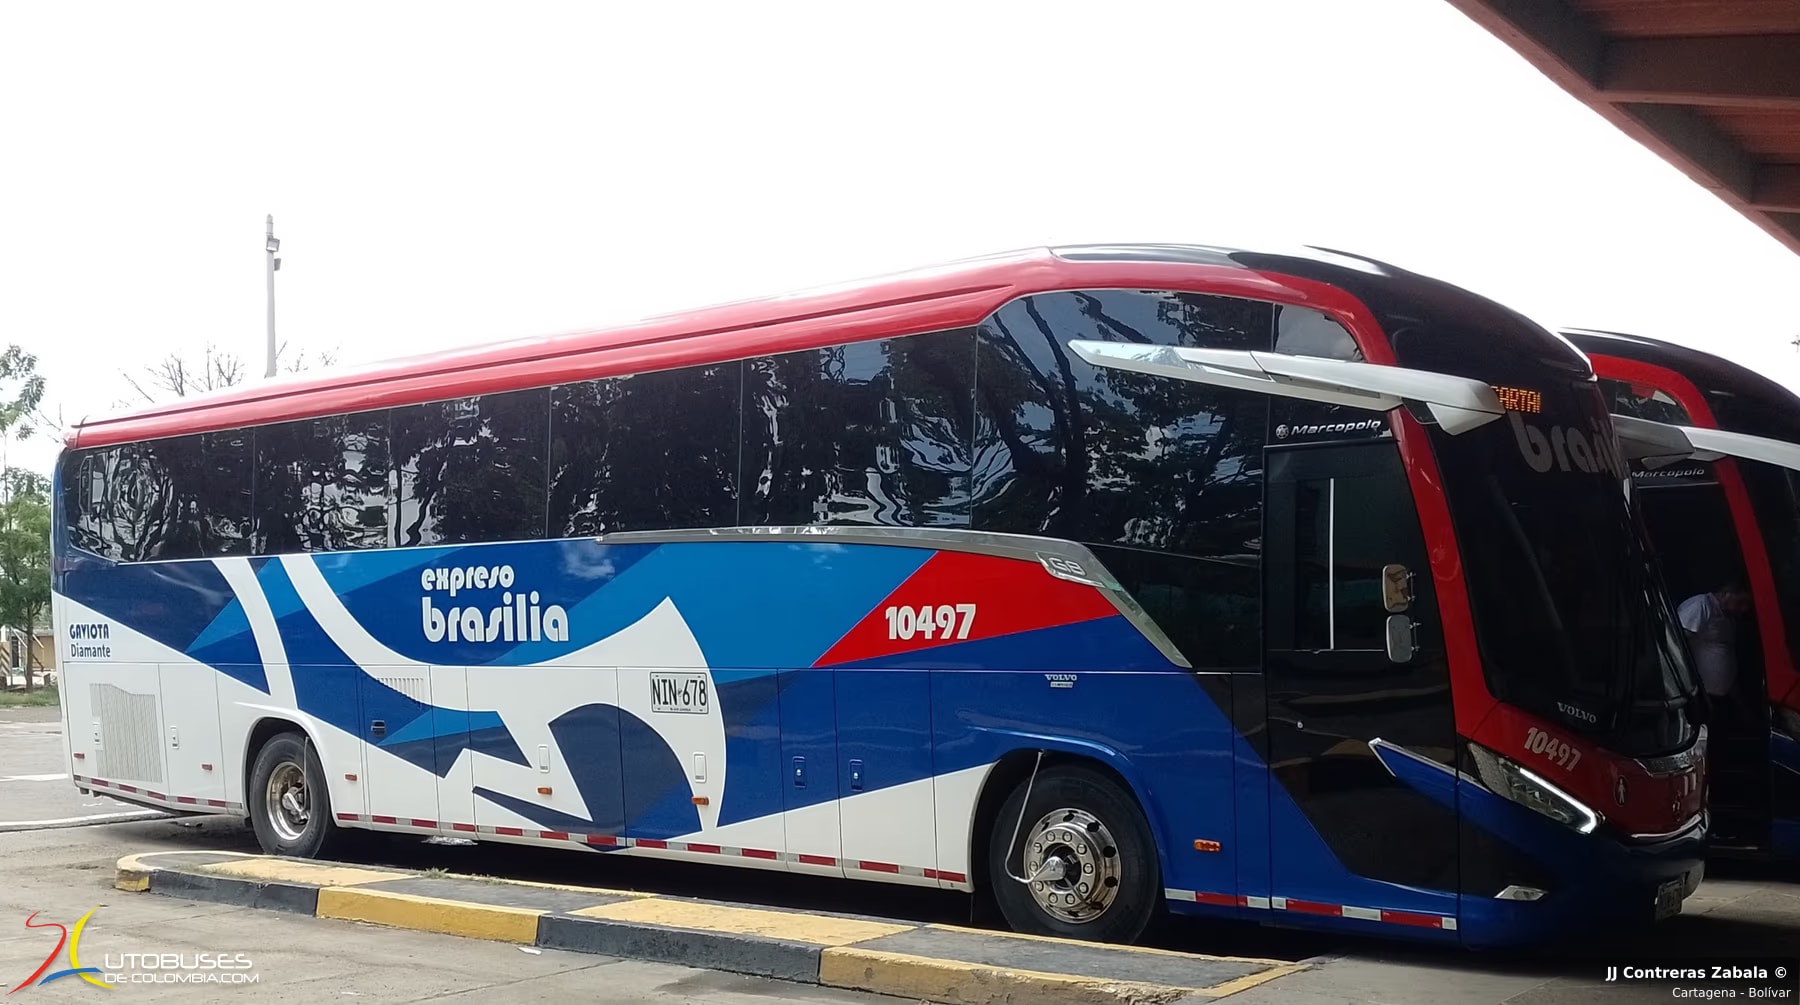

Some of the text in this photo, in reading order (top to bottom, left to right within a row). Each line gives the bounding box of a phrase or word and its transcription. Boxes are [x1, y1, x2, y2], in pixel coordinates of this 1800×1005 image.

[1290, 419, 1381, 436] Marcopolo
[421, 565, 514, 597] expreso
[421, 590, 569, 643] brasilia
[885, 603, 977, 640] 10497
[69, 623, 110, 640] GAVIOTA
[70, 643, 111, 658] Diamante
[1044, 673, 1078, 682] VOLVO
[1557, 701, 1597, 724] VOLVO
[1524, 727, 1582, 772] 10497
